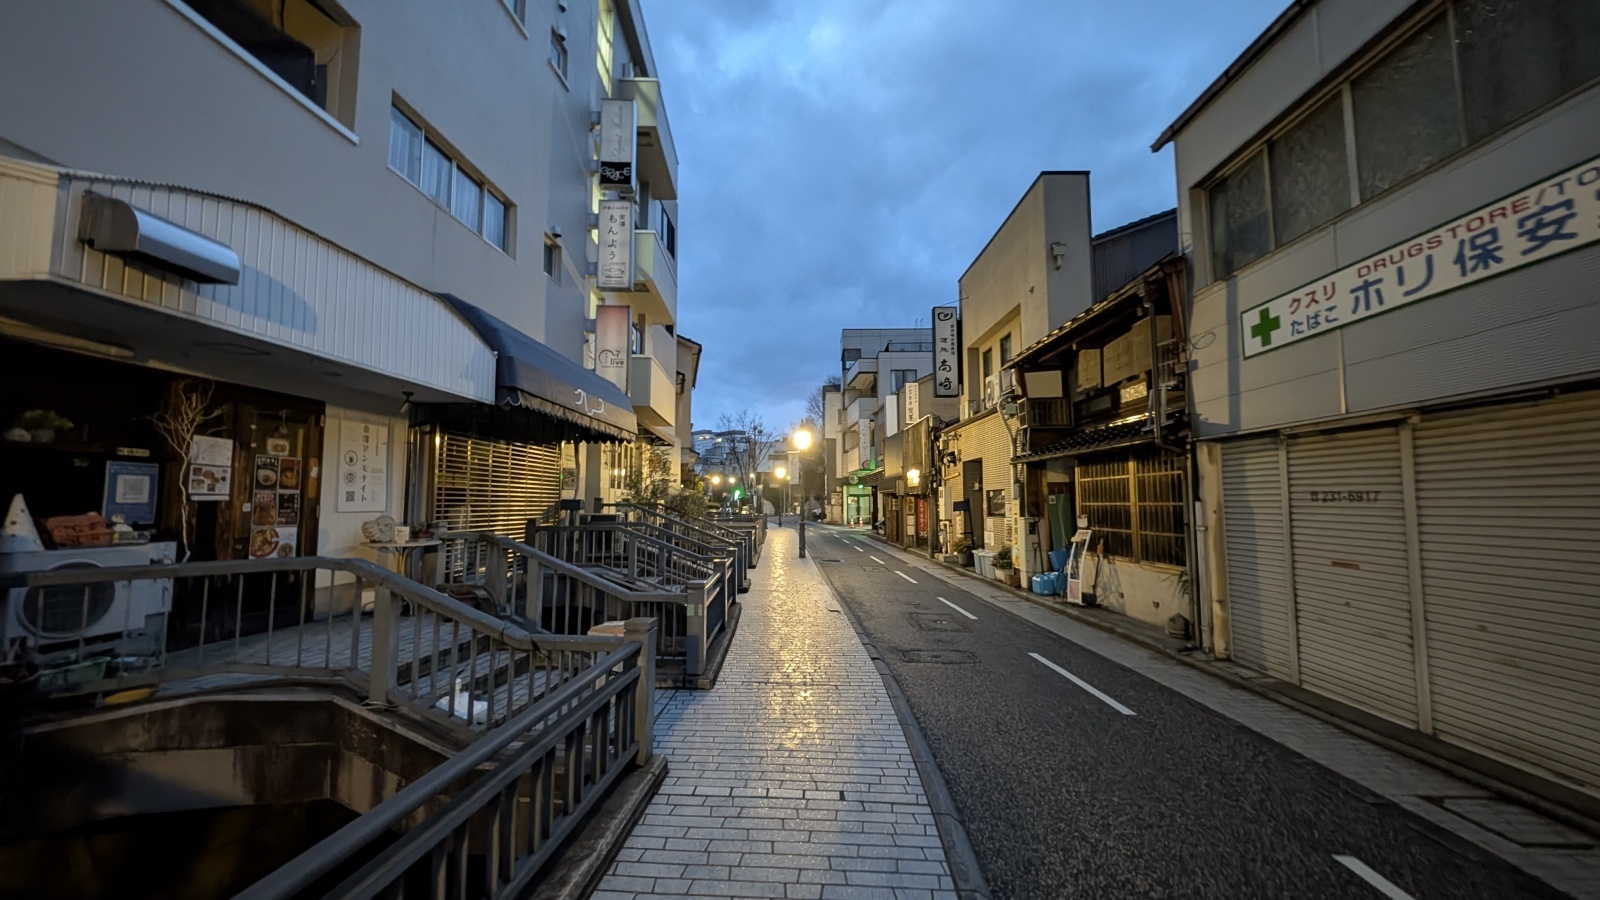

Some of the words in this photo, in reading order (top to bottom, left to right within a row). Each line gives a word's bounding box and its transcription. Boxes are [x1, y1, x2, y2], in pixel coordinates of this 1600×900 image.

[607, 213, 618, 260] もんよう
[1349, 187, 1600, 314] ホリ保安
[1288, 281, 1337, 315] クスリ
[1290, 305, 1339, 336] たばこ
